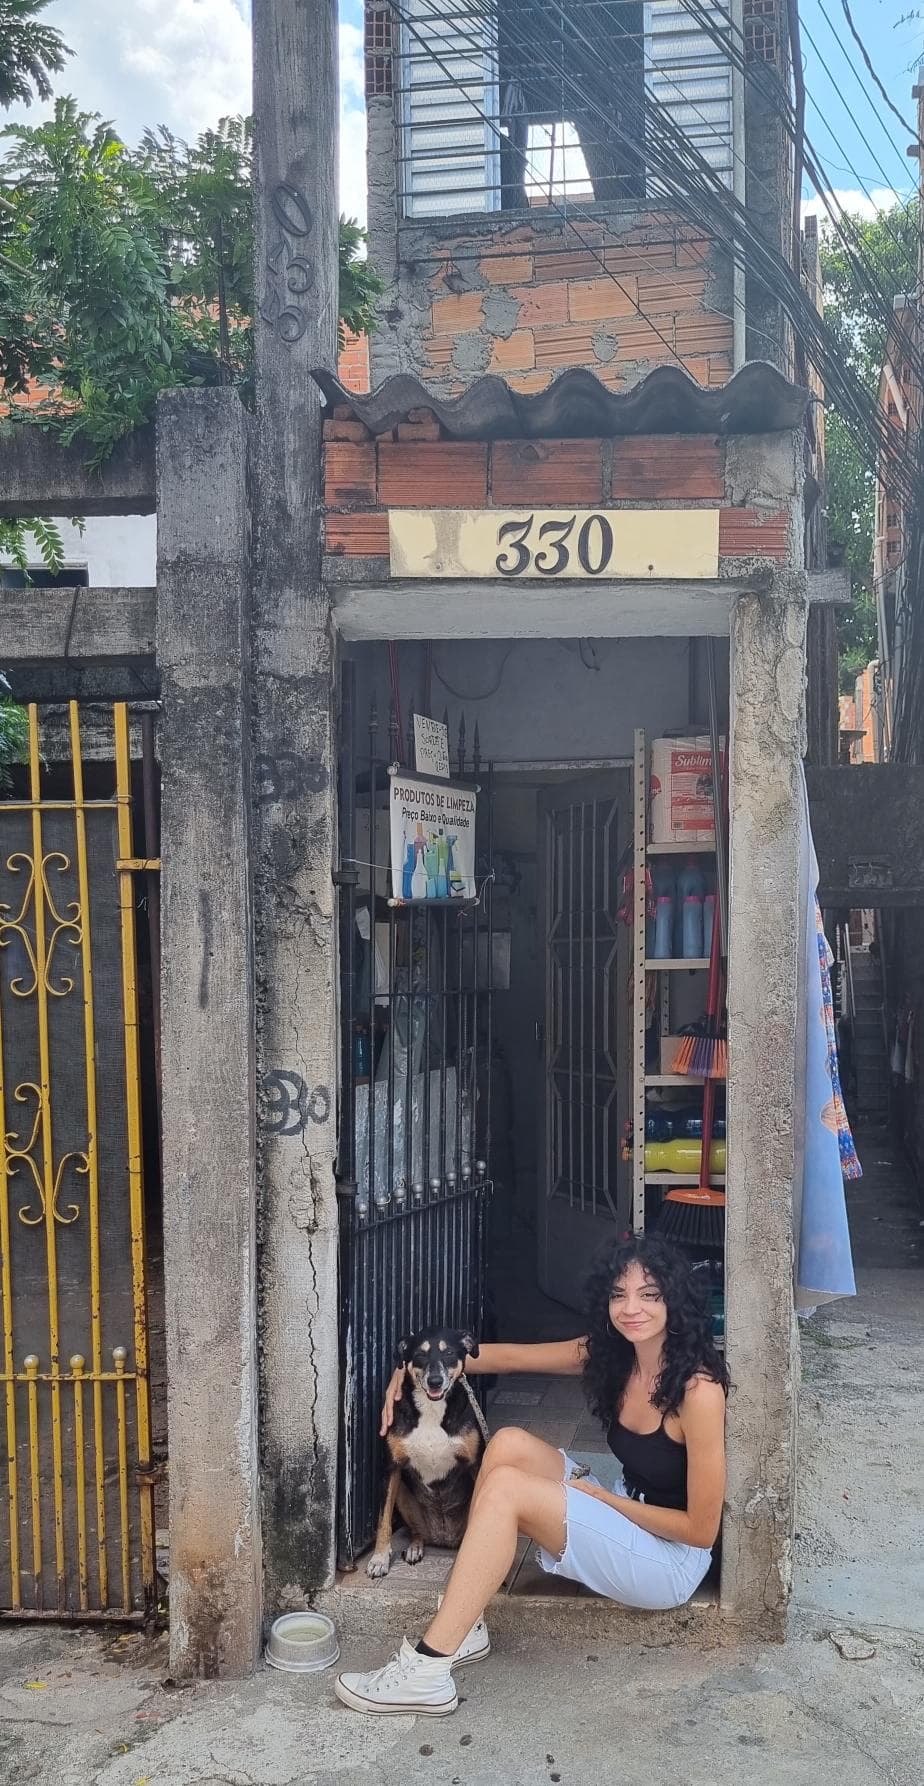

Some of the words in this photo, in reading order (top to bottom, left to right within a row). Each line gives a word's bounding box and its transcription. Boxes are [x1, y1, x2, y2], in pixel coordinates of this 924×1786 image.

[496, 514, 613, 575] 330
[675, 755, 713, 767] Sublim
[393, 787, 435, 806] PRODUTOS
[436, 795, 445, 808] DE
[446, 796, 475, 813] LIMPEZA
[402, 806, 419, 822] Preço
[420, 810, 437, 823] Baixo
[437, 815, 442, 824] e
[442, 813, 470, 828] Qualidade
